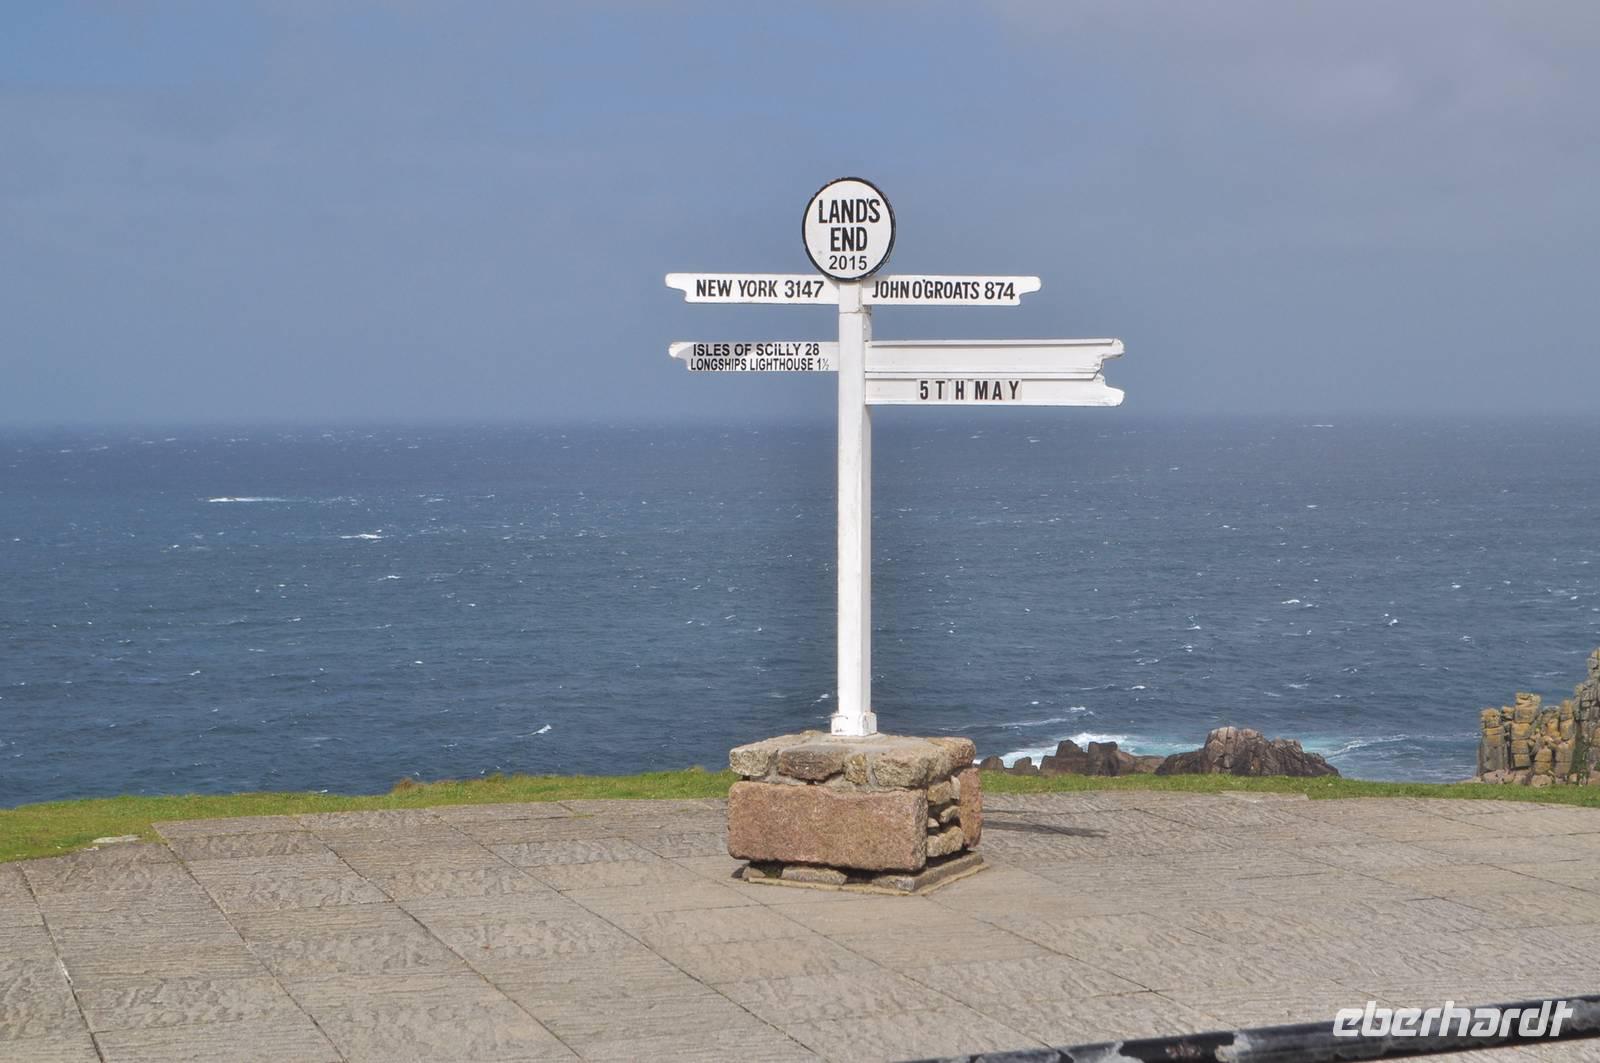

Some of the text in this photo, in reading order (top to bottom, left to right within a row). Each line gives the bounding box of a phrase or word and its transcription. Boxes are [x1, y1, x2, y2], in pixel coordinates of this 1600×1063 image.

[818, 199, 881, 224] LAND'S
[830, 226, 868, 252] END
[828, 255, 868, 271] 2015
[696, 279, 825, 299] NEW YORK 3147
[872, 279, 1016, 300] JOHN O'GROATS 874
[692, 343, 820, 357] ISLES OF SCILLY 28
[690, 357, 747, 371] LONGSHIPS
[749, 357, 814, 371] LIGHTHOUSE
[974, 380, 1020, 401] MAY
